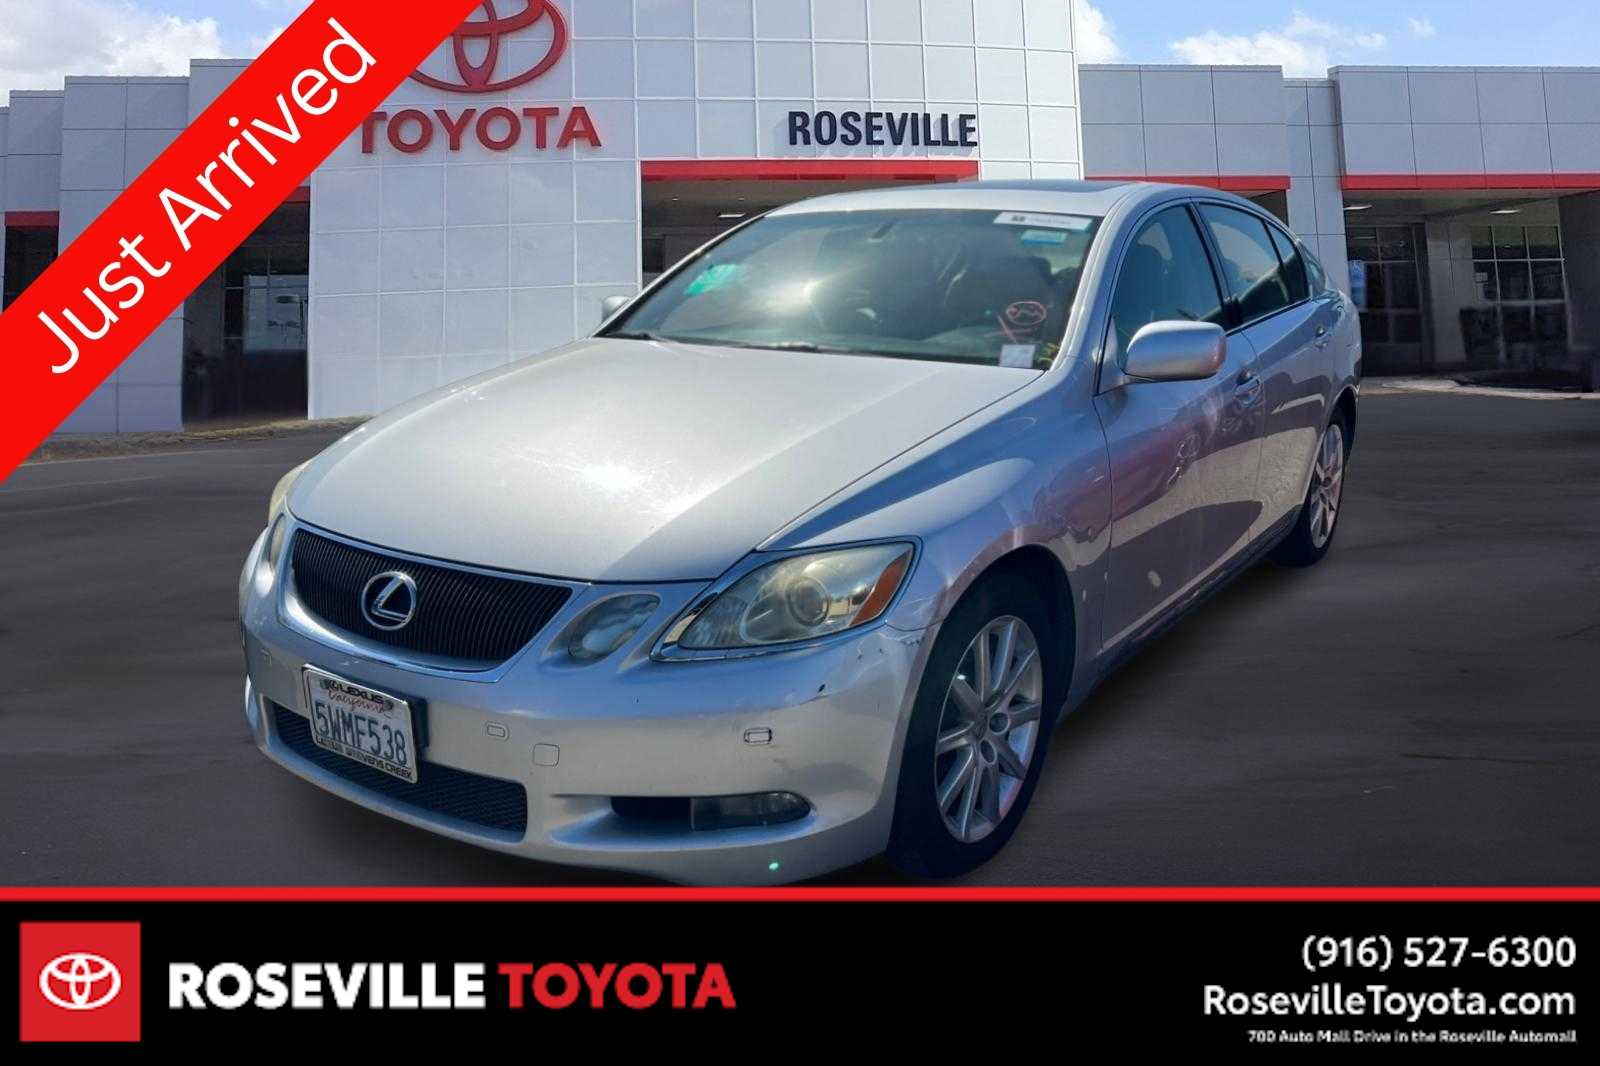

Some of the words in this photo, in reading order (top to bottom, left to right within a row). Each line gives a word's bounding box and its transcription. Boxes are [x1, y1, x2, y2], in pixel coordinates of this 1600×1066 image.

[361, 106, 602, 154] TOYOTA
[788, 110, 978, 147] ROSEVILLE
[314, 700, 408, 767] 5WMF538
